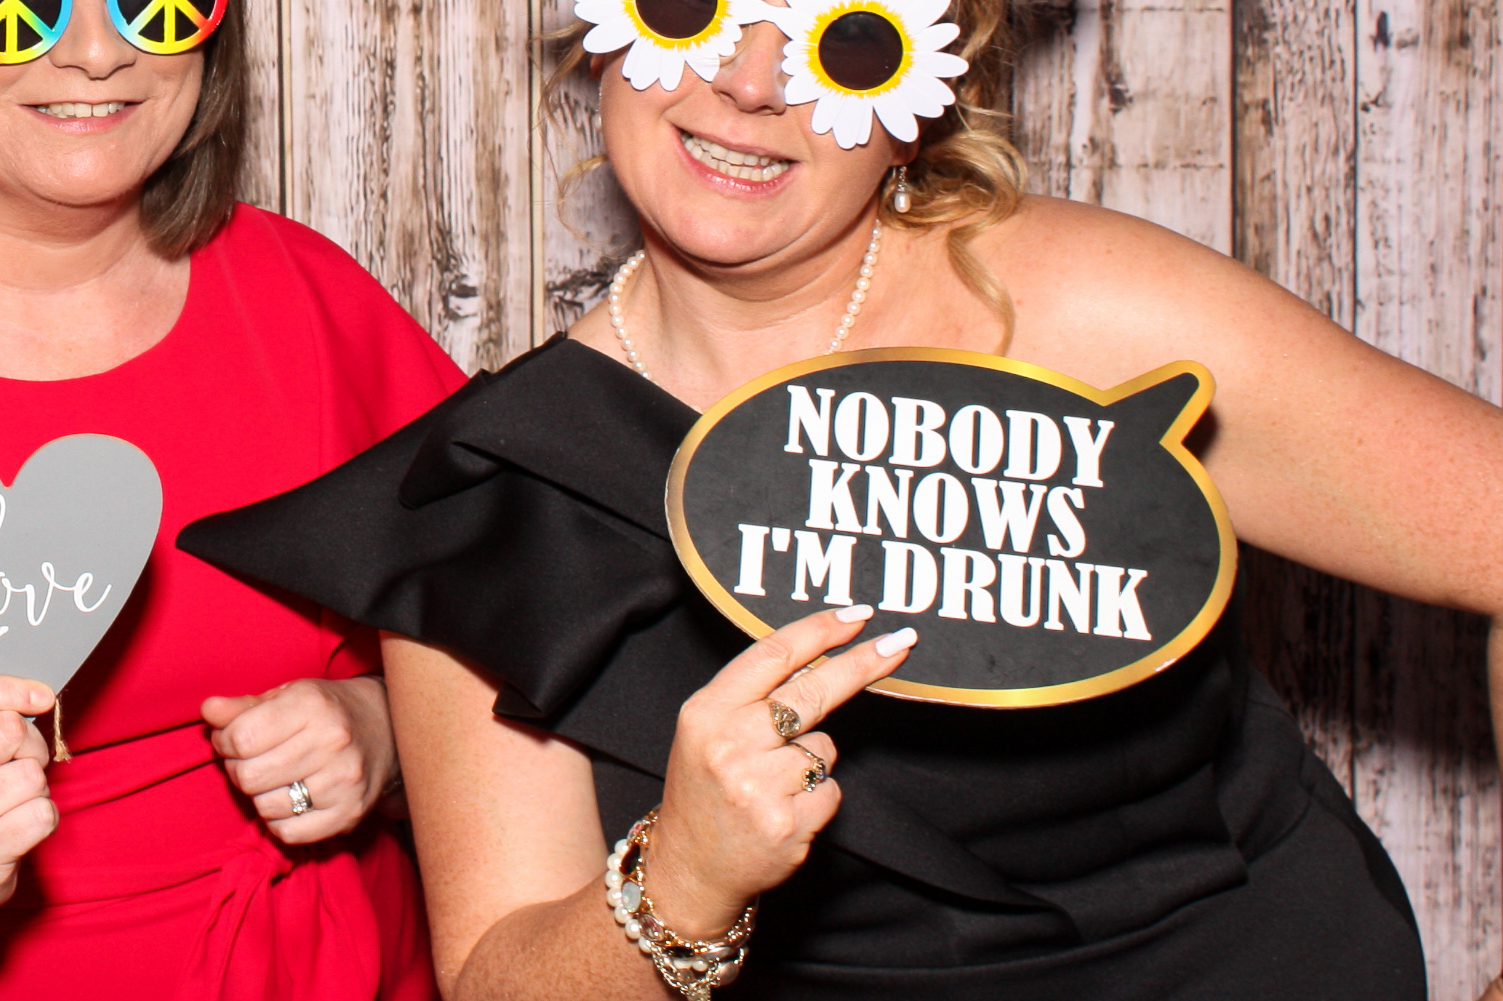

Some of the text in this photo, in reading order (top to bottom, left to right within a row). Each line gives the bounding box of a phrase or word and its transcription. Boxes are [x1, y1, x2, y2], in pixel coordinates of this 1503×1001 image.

[783, 384, 1115, 488] NOBODY
[805, 458, 1086, 558] KNOWS
[733, 523, 1152, 641] I'M DRUNK
